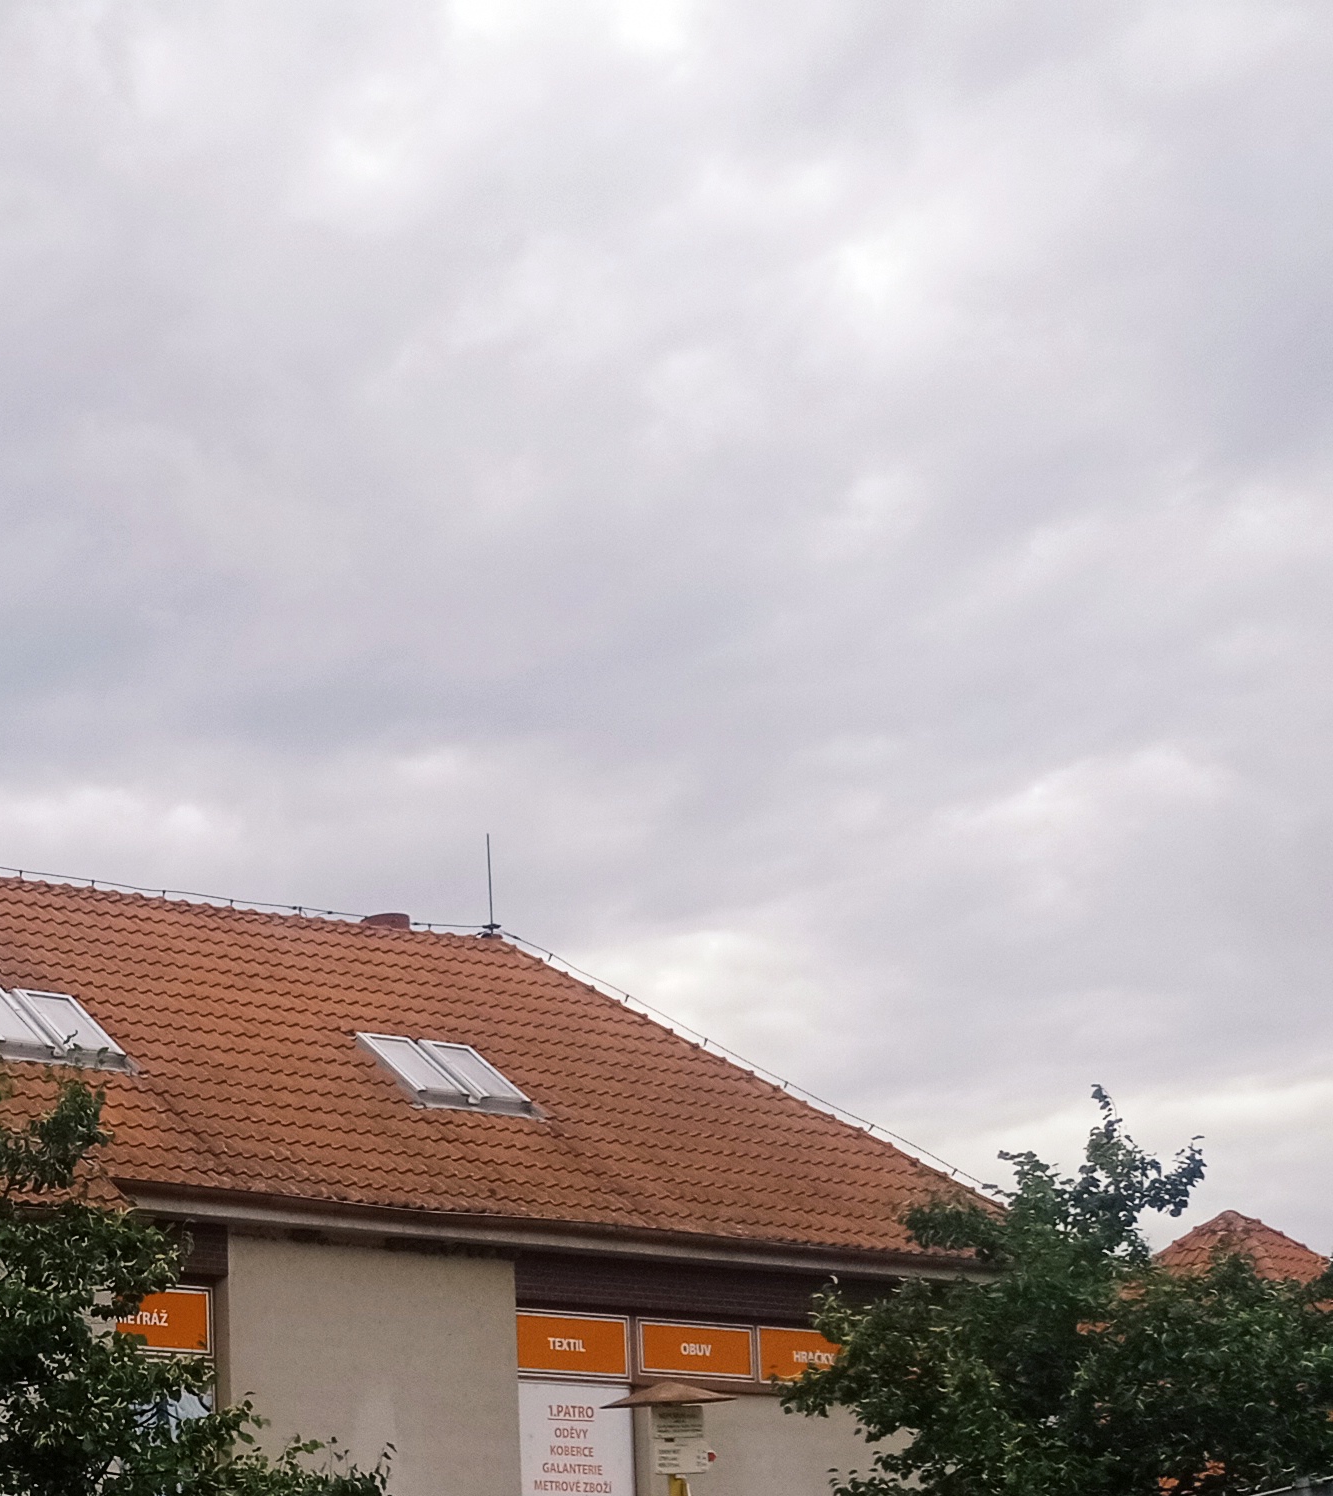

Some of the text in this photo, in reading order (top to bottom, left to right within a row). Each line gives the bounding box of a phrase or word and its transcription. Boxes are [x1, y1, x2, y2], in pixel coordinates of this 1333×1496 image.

[548, 1337, 586, 1352] TEXTIL
[680, 1343, 712, 1357] OBUV
[793, 1349, 836, 1366] HRAČKY
[547, 1404, 595, 1419] 1.PATRO
[554, 1426, 589, 1440] ODĚVY
[549, 1445, 594, 1458] KOBERCE
[542, 1462, 604, 1476] GALANTERIE
[534, 1479, 613, 1494] METROVÉ ZBOŽÍ
